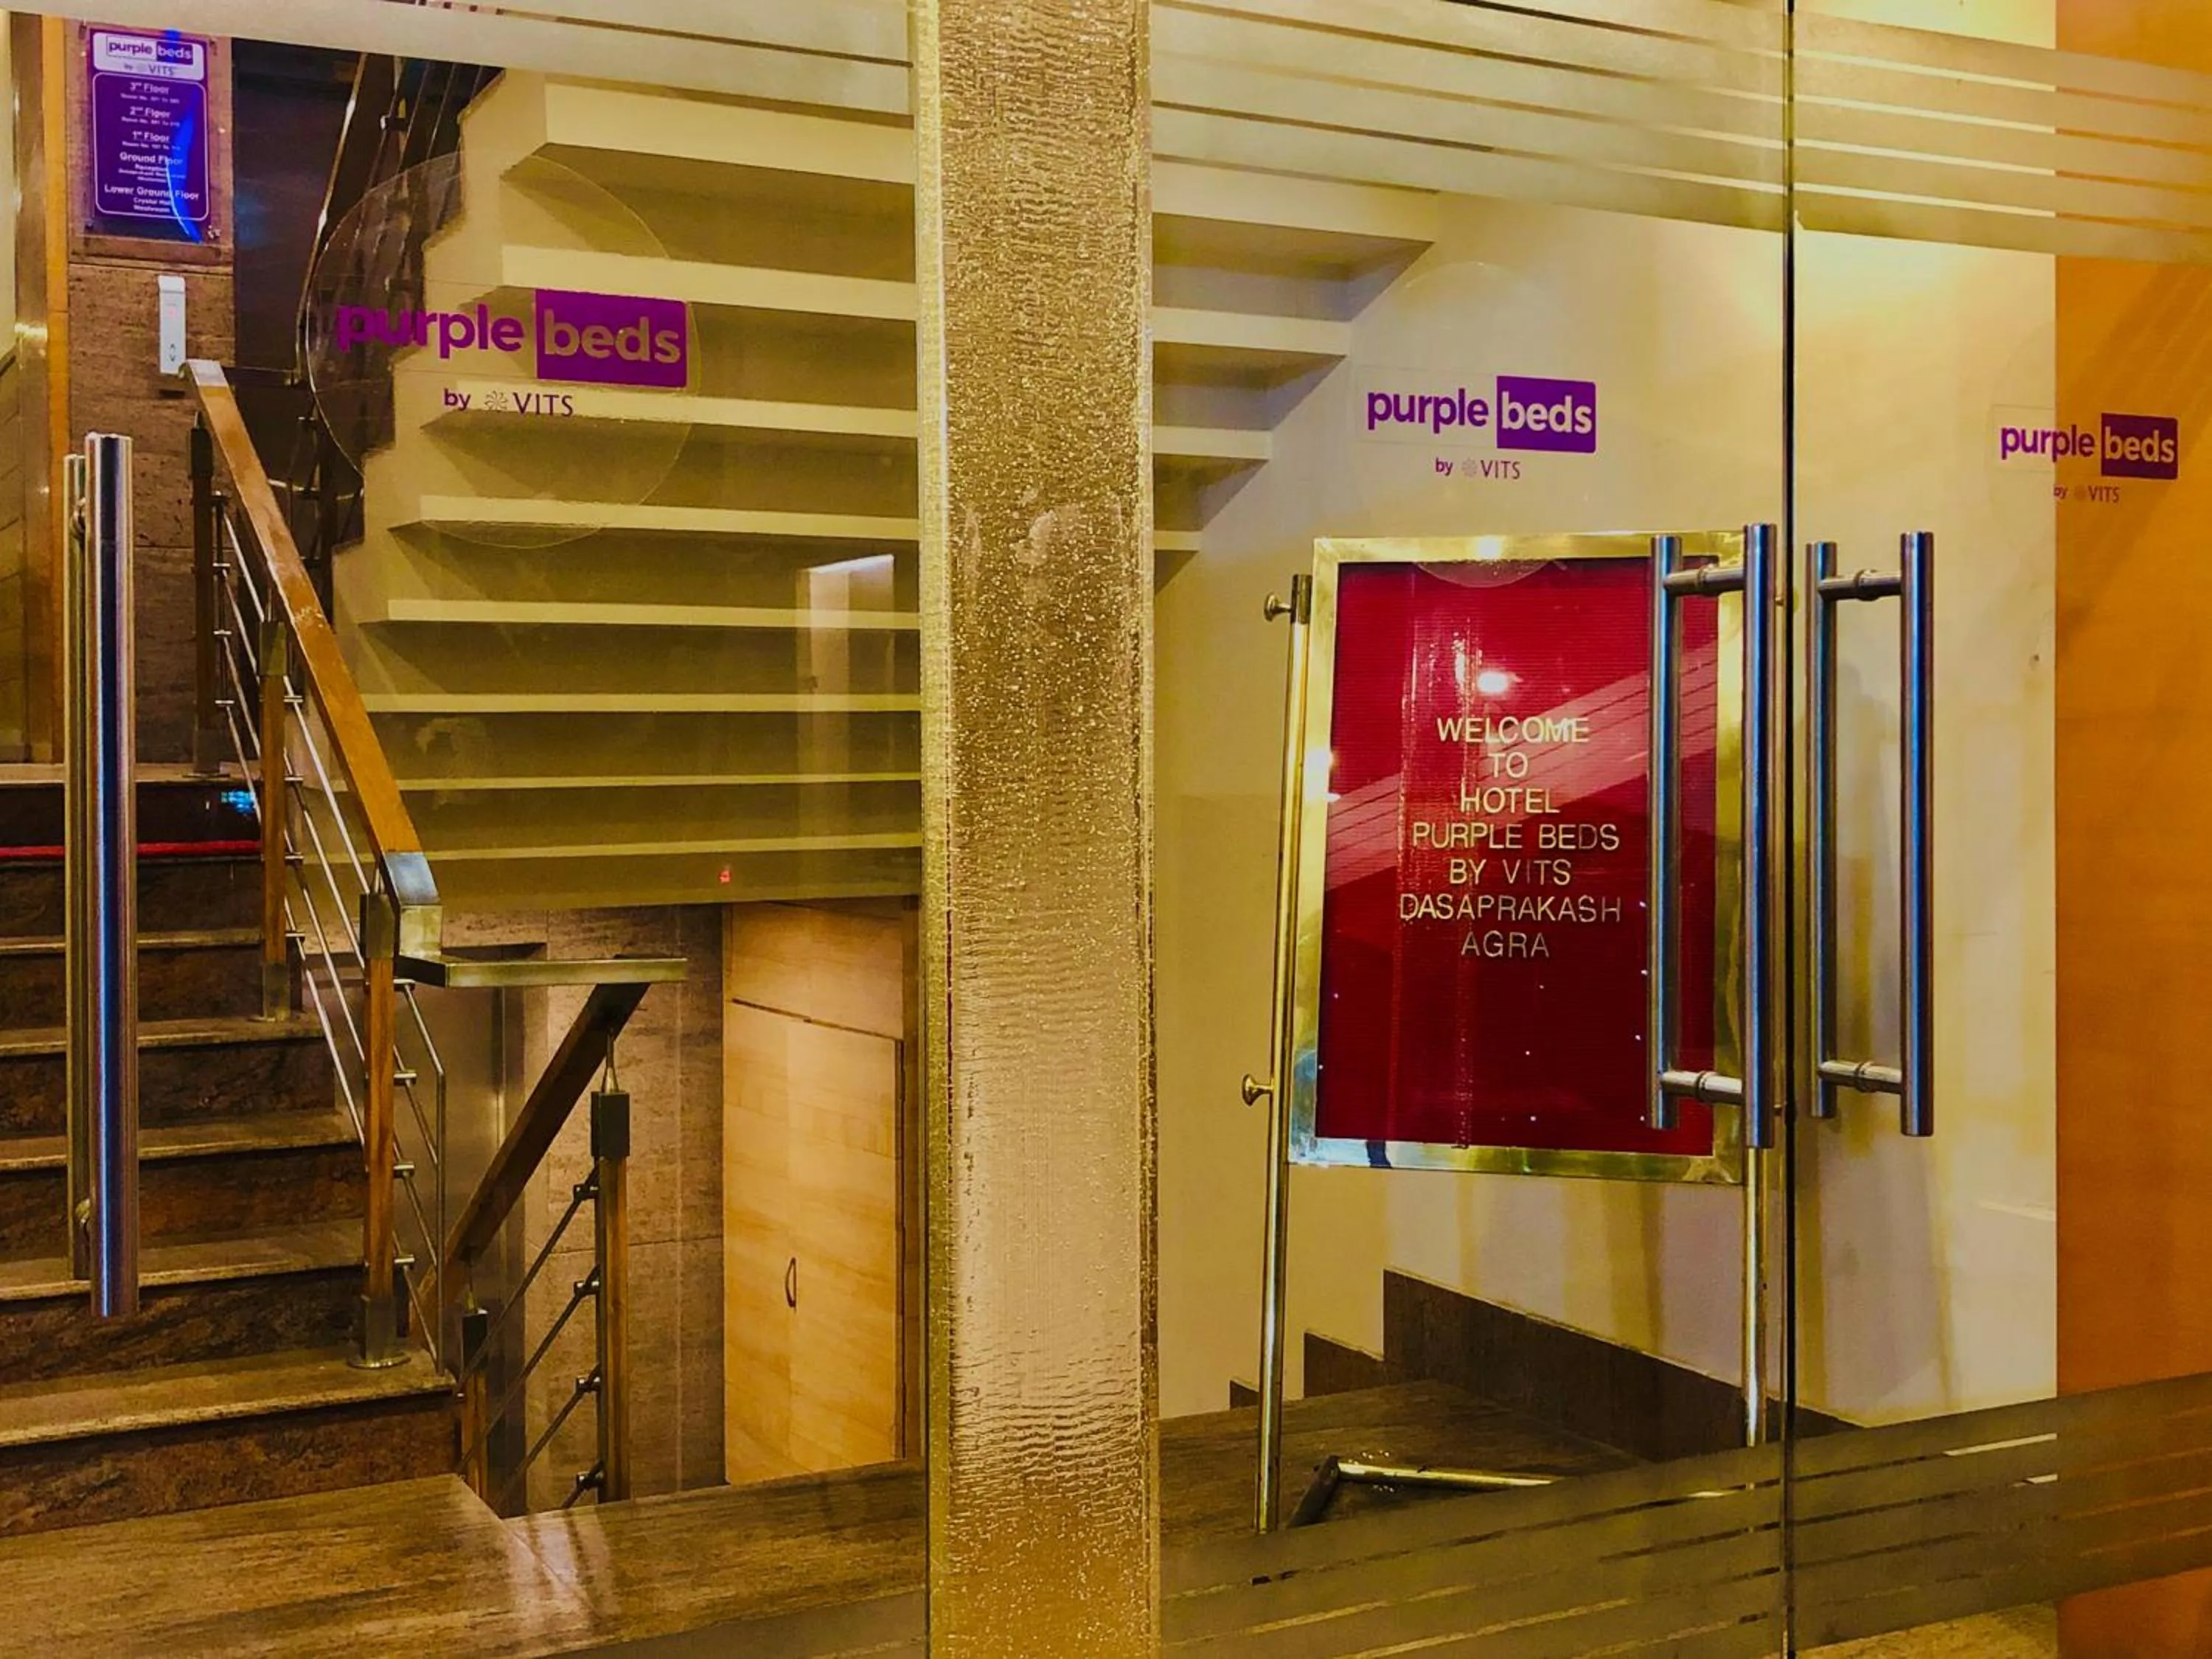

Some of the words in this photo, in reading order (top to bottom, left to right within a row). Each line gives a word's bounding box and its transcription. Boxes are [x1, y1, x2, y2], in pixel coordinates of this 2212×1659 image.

[108, 41, 153, 55] purple
[158, 44, 192, 59] beds
[148, 65, 175, 75] VITS
[144, 83, 170, 94] Floor
[145, 107, 170, 119] Floor
[144, 131, 170, 143] Floor
[119, 151, 156, 164] Ground
[158, 154, 184, 165] Floor
[104, 184, 134, 195] Lower
[136, 187, 171, 197] Ground
[175, 189, 199, 200] Floor
[335, 303, 524, 359] purple
[543, 309, 681, 364] beds
[444, 388, 471, 411] by
[512, 392, 574, 417] VITS
[1368, 388, 1489, 434] purple
[1502, 391, 1593, 434] beds
[2001, 425, 2095, 462] purple
[2104, 425, 2175, 463] beds
[1436, 458, 1453, 476] by
[1480, 459, 1520, 480] VITS
[2087, 485, 2120, 503] VITS
[1437, 717, 1589, 744] WELCOME
[1489, 752, 1528, 778] TO
[1461, 787, 1560, 814] HOTEL
[1413, 822, 1523, 849] PURPLE
[1539, 824, 1620, 851] BEDS
[1450, 859, 1486, 885] BY
[1503, 860, 1572, 886] VITS
[1400, 893, 1621, 922] DASAPRAKASH
[1461, 931, 1549, 958] AGRA
